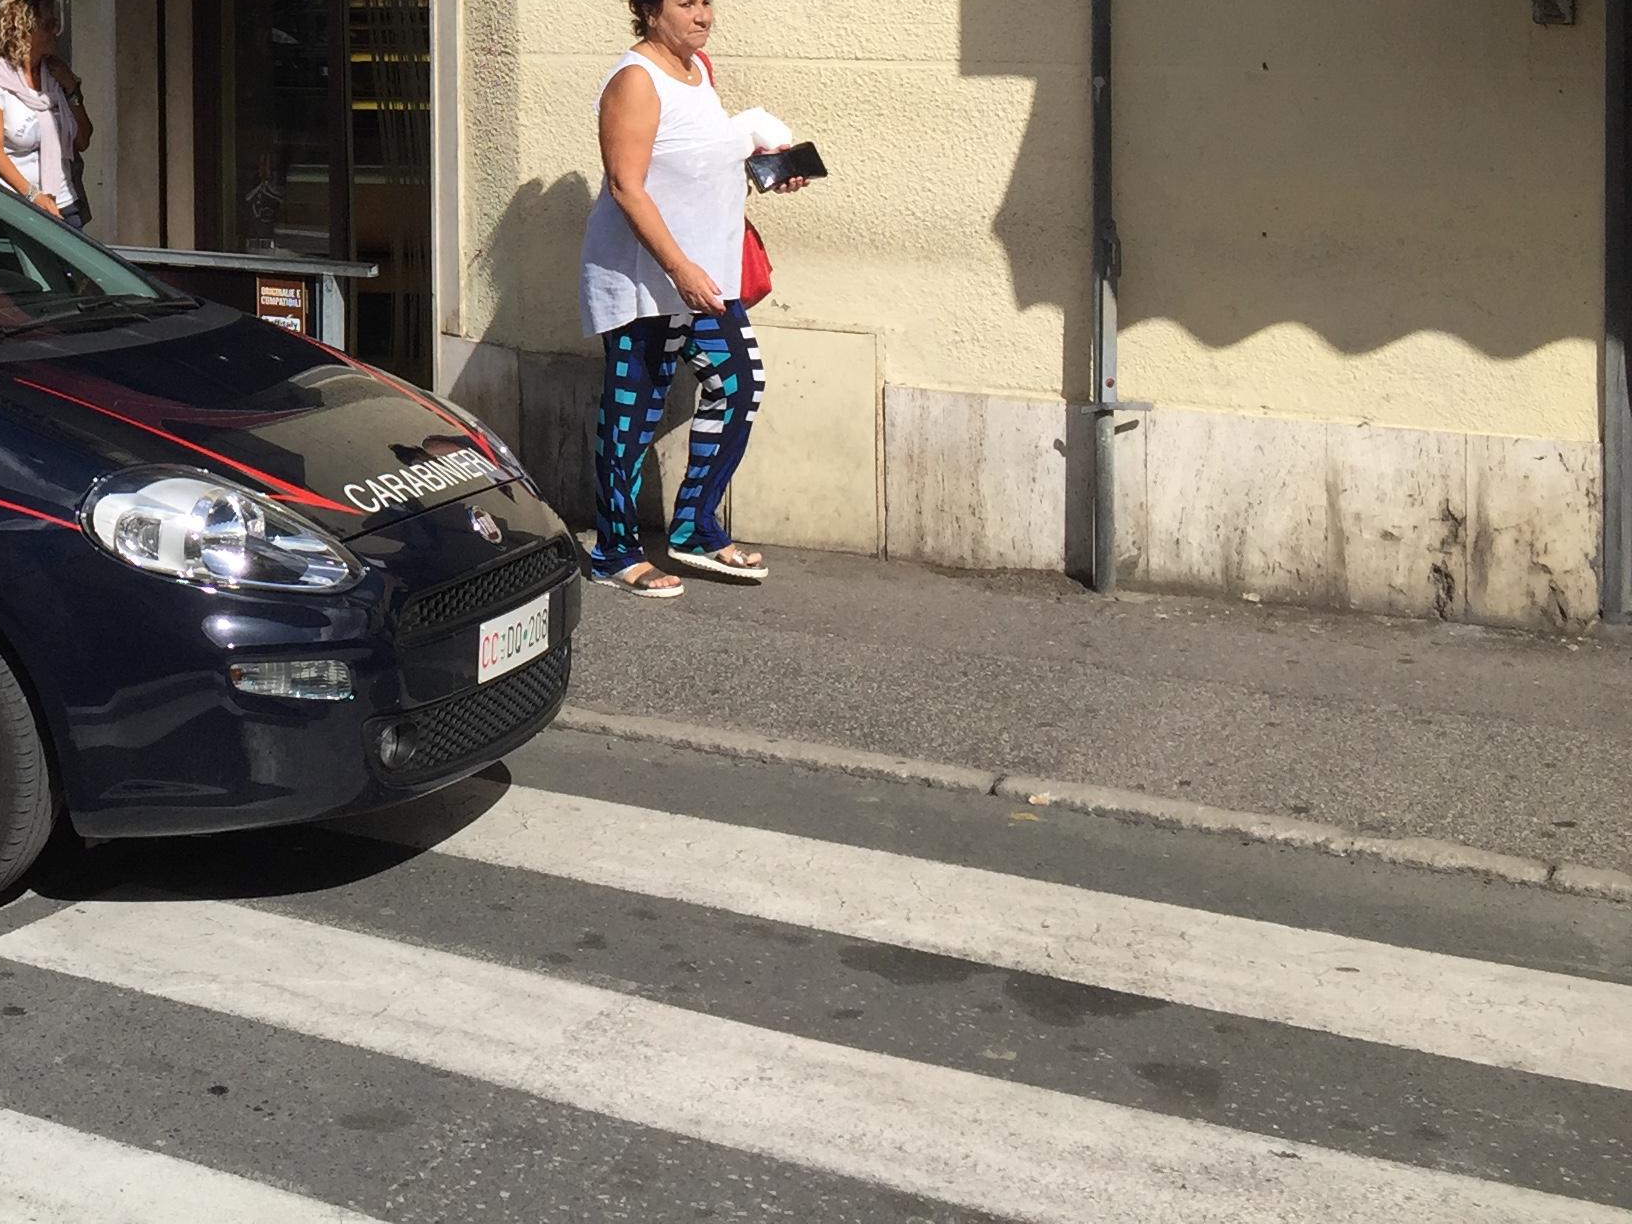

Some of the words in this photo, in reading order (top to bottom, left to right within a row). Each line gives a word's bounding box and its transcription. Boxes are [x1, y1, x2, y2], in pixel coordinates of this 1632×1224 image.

[343, 447, 498, 513] CARABINIERI
[481, 632, 499, 669] CC
[528, 608, 548, 648] 208
